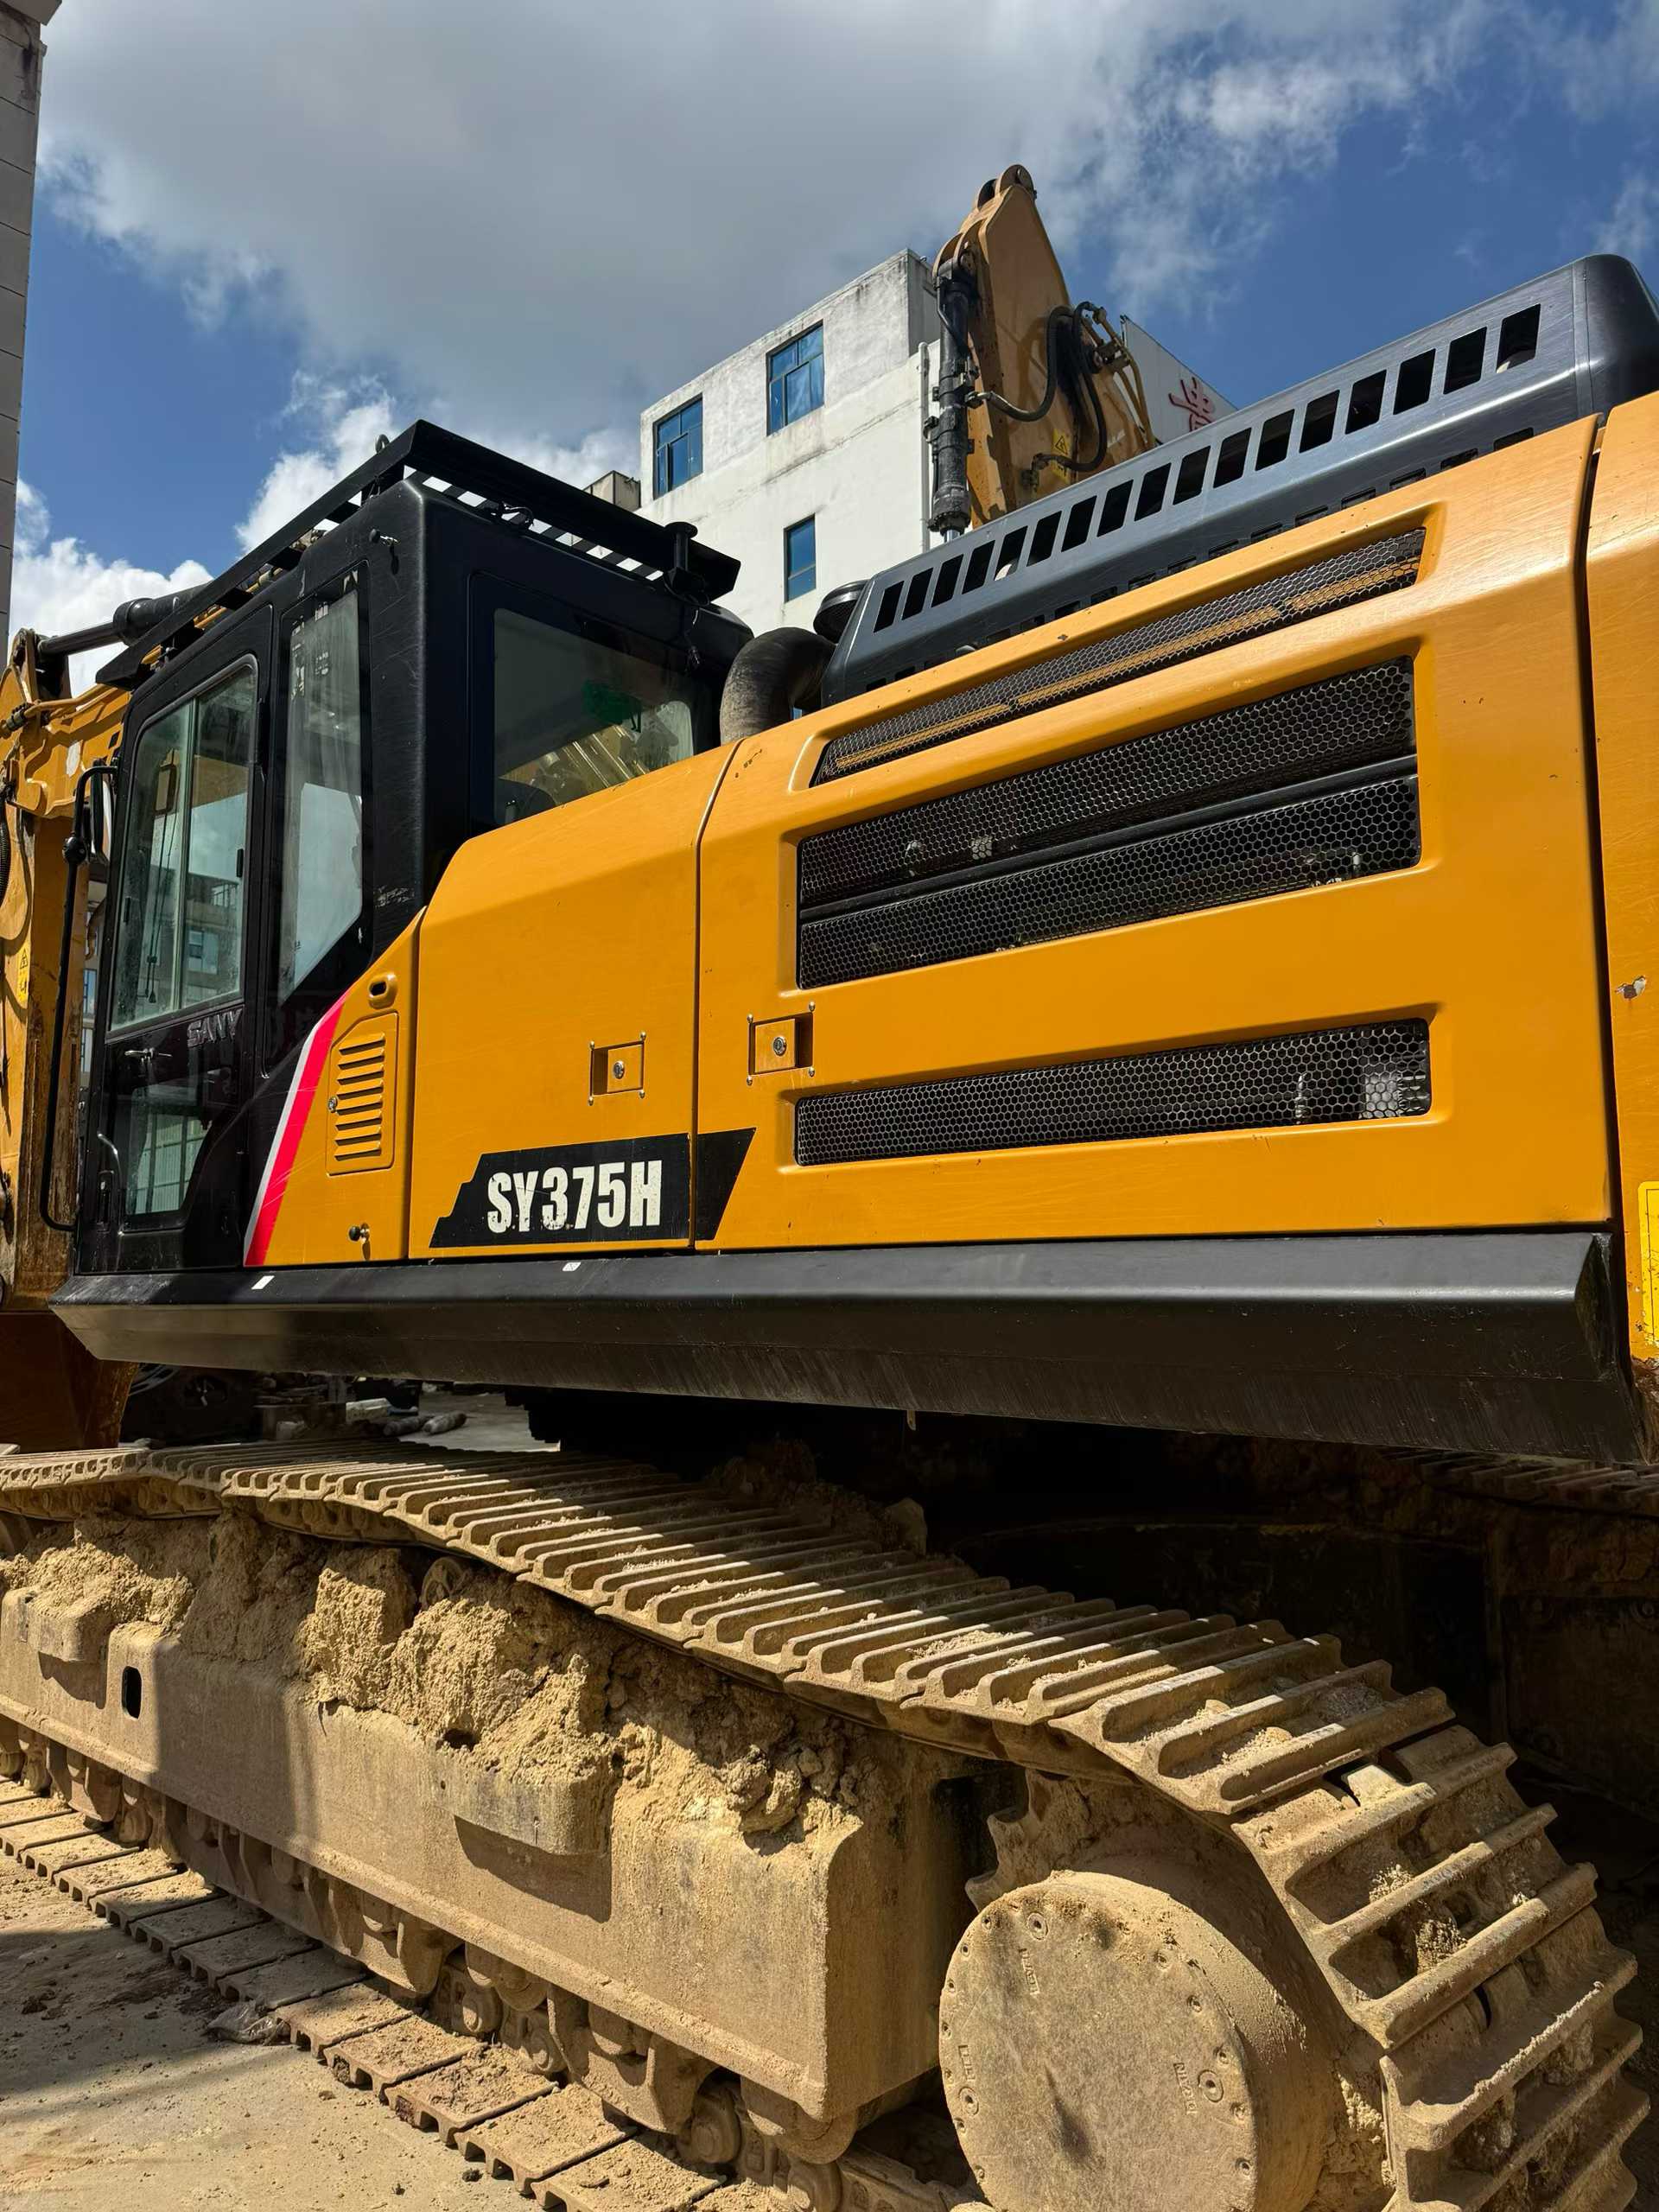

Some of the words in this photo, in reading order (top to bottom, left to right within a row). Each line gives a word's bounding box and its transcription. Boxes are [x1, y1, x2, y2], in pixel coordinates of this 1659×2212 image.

[187, 1008, 243, 1047] SANY
[487, 1160, 662, 1234] SY375H
[1174, 2063, 1198, 2113] DRAIN
